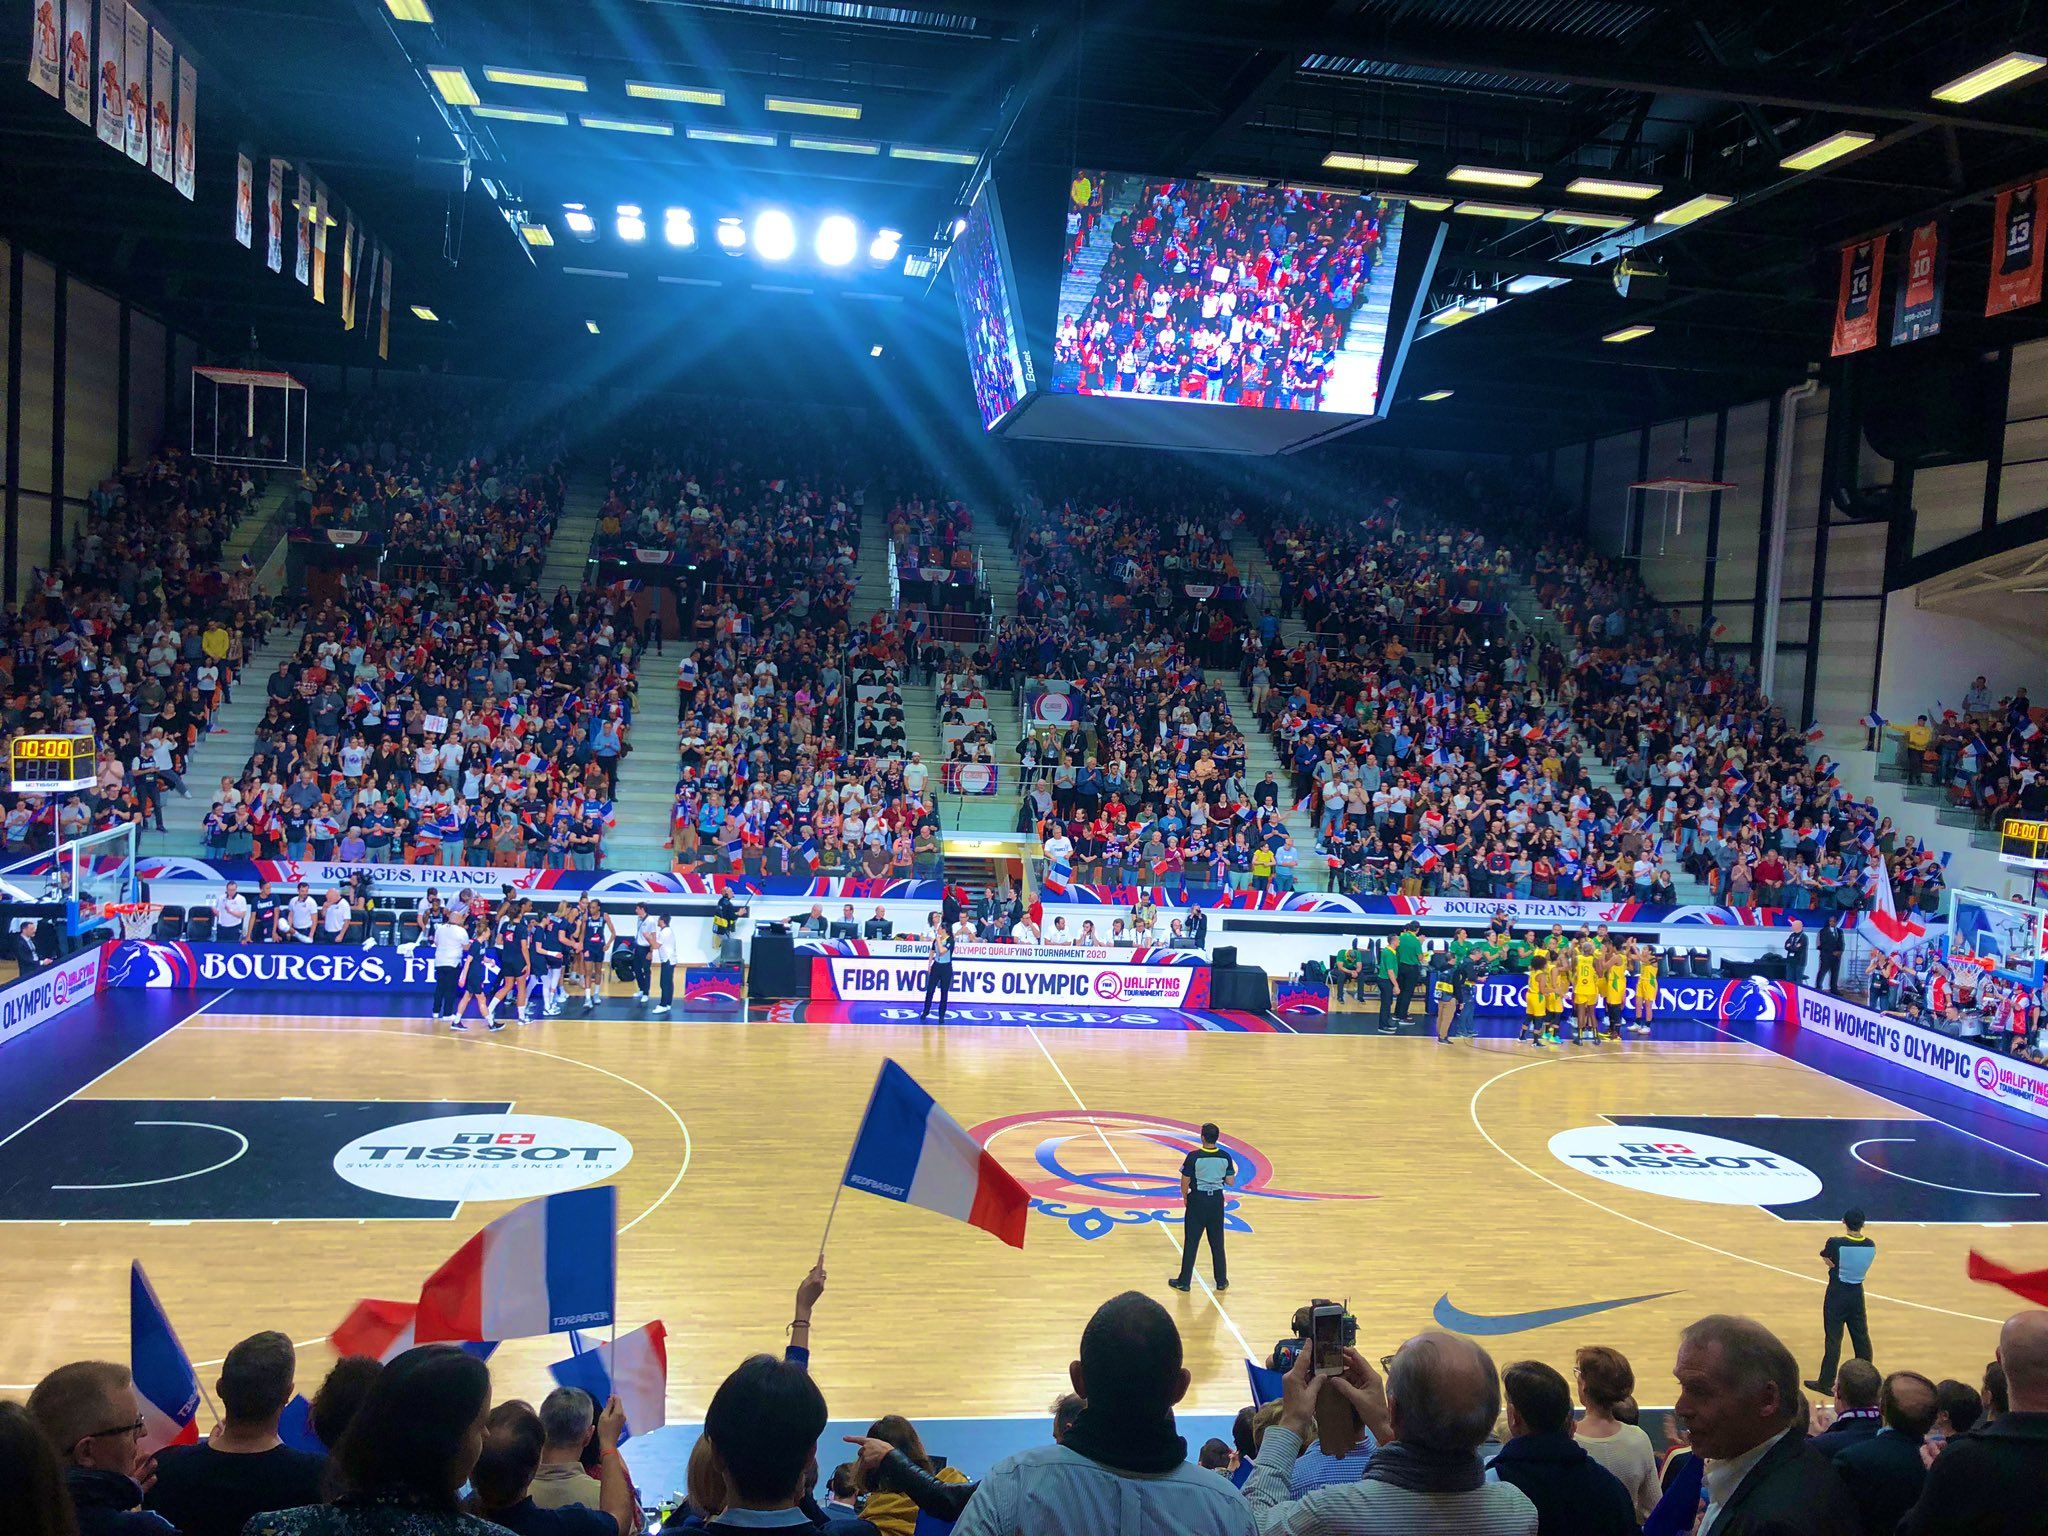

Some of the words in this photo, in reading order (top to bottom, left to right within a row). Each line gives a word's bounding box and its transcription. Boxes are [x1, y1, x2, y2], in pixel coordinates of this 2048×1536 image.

[2009, 221, 2030, 246] 13
[1912, 256, 1931, 279] 10
[1852, 274, 1868, 295] 14
[1022, 350, 1036, 383] Bodet
[20, 741, 70, 757] 10:00
[2008, 822, 2037, 839] 10:00
[422, 869, 499, 885] FRANCE
[1525, 904, 1588, 918] FRANCE
[895, 944, 913, 953] FIBA
[953, 946, 987, 955] OLYMPIC
[988, 947, 1033, 957] QUALIFYING
[1034, 948, 1086, 959] TOURNAMENT
[1086, 950, 1107, 959] 2020
[200, 953, 392, 984] BOURGES,
[1580, 965, 1590, 977] 16
[842, 968, 890, 991] FIBA
[895, 969, 996, 994] WOEN'S
[1001, 972, 1090, 996] OLYMPIC
[1123, 989, 1163, 997] TOURNAMENT
[1163, 990, 1180, 998] 2020
[3, 982, 52, 1030] OLYMPIC
[1802, 998, 1831, 1028] FIBA
[1834, 1008, 1901, 1052] WOMEN'S
[1904, 1034, 1971, 1079] OLYMPIC
[358, 1146, 617, 1161] TISSOT
[1569, 1154, 1781, 1170] TISSOT
